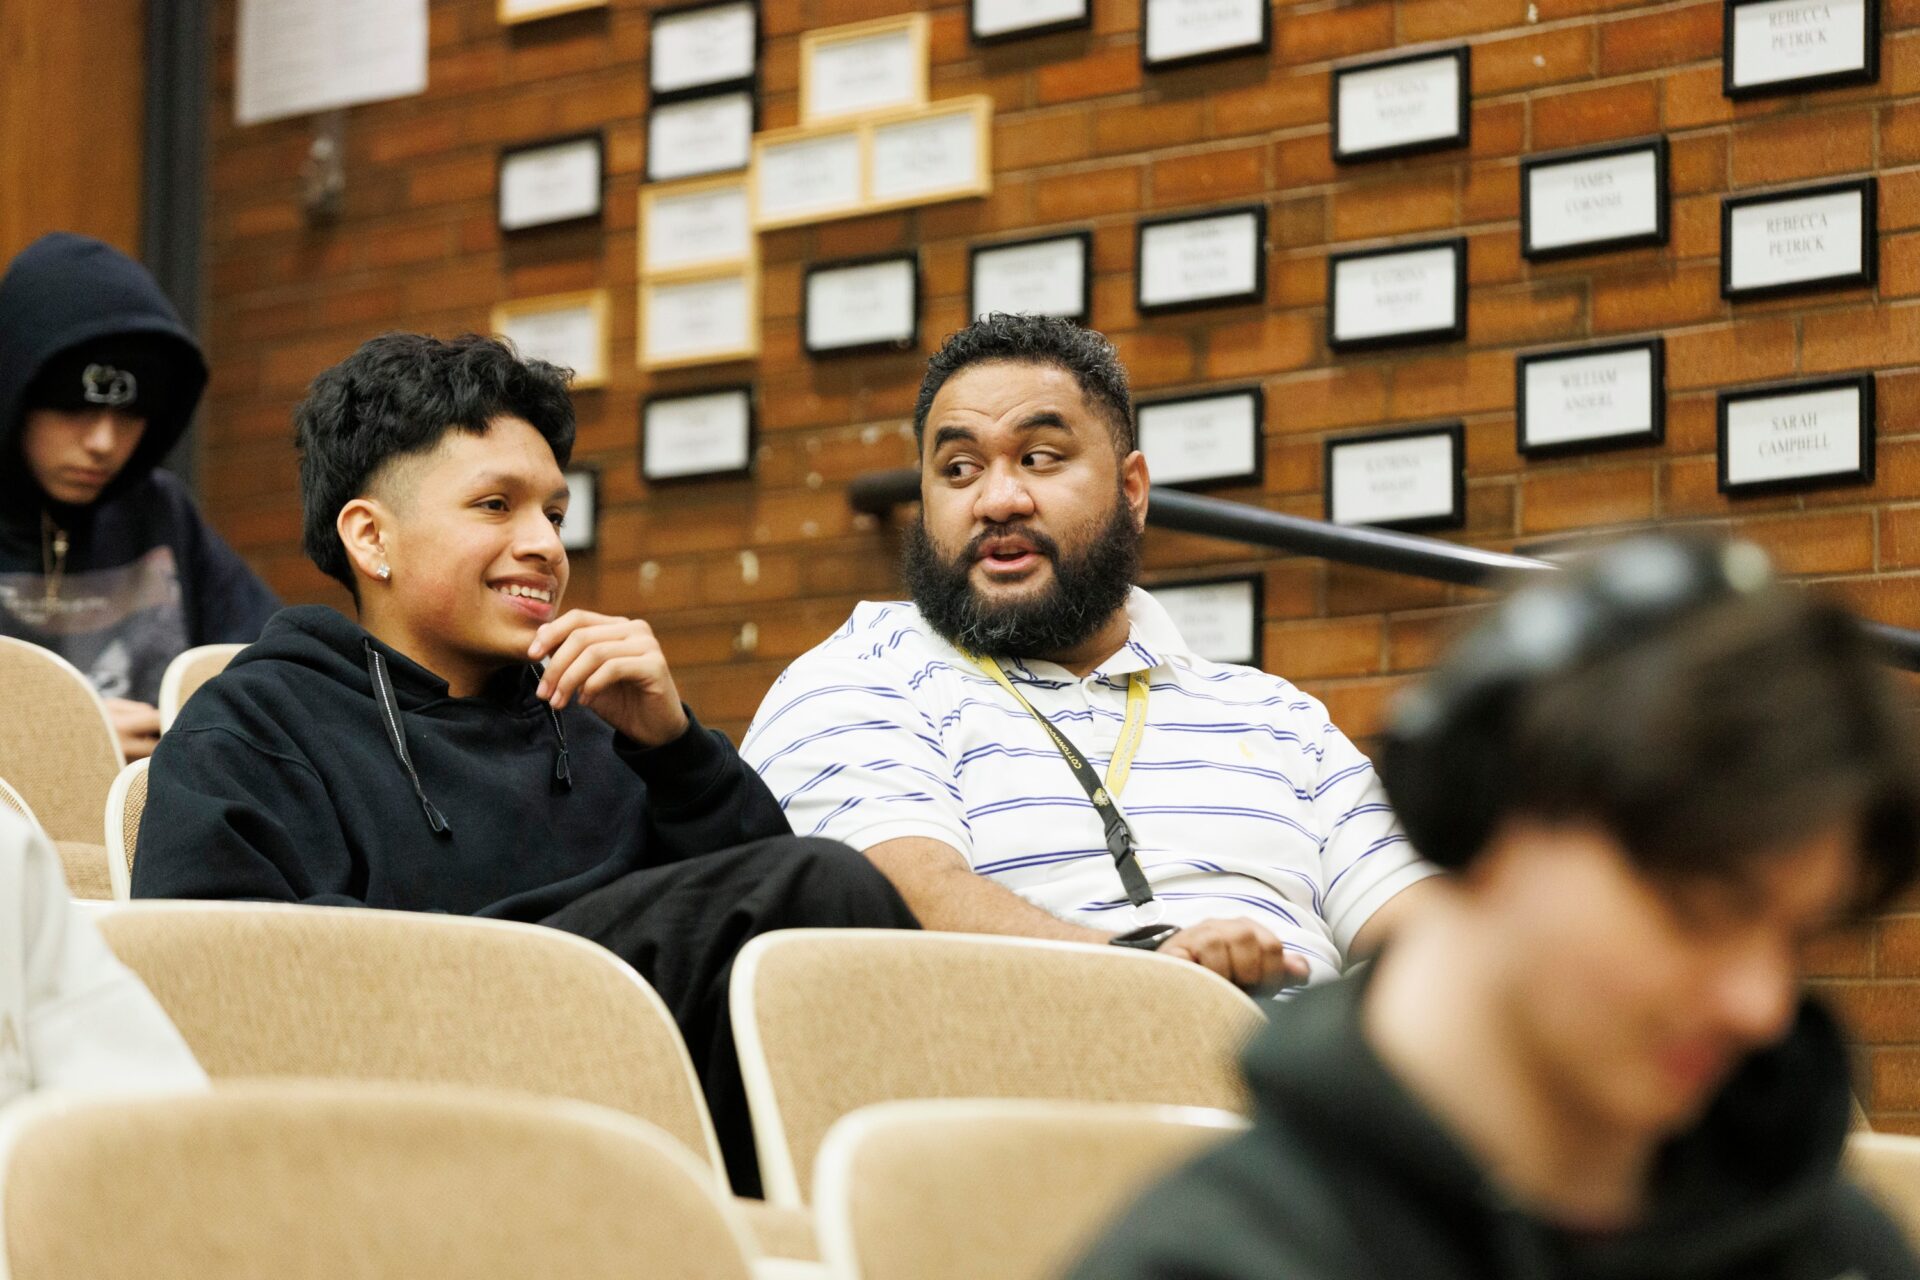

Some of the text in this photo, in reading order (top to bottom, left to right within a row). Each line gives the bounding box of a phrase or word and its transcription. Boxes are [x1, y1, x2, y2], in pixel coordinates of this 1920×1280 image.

[1769, 6, 1832, 27] REBECCA
[1772, 29, 1827, 50] PETRICK
[1767, 212, 1829, 233] REBECCA
[1769, 235, 1825, 257] PETRICK
[1772, 411, 1818, 432] SARAH
[1758, 432, 1831, 458] CAMPBELL
